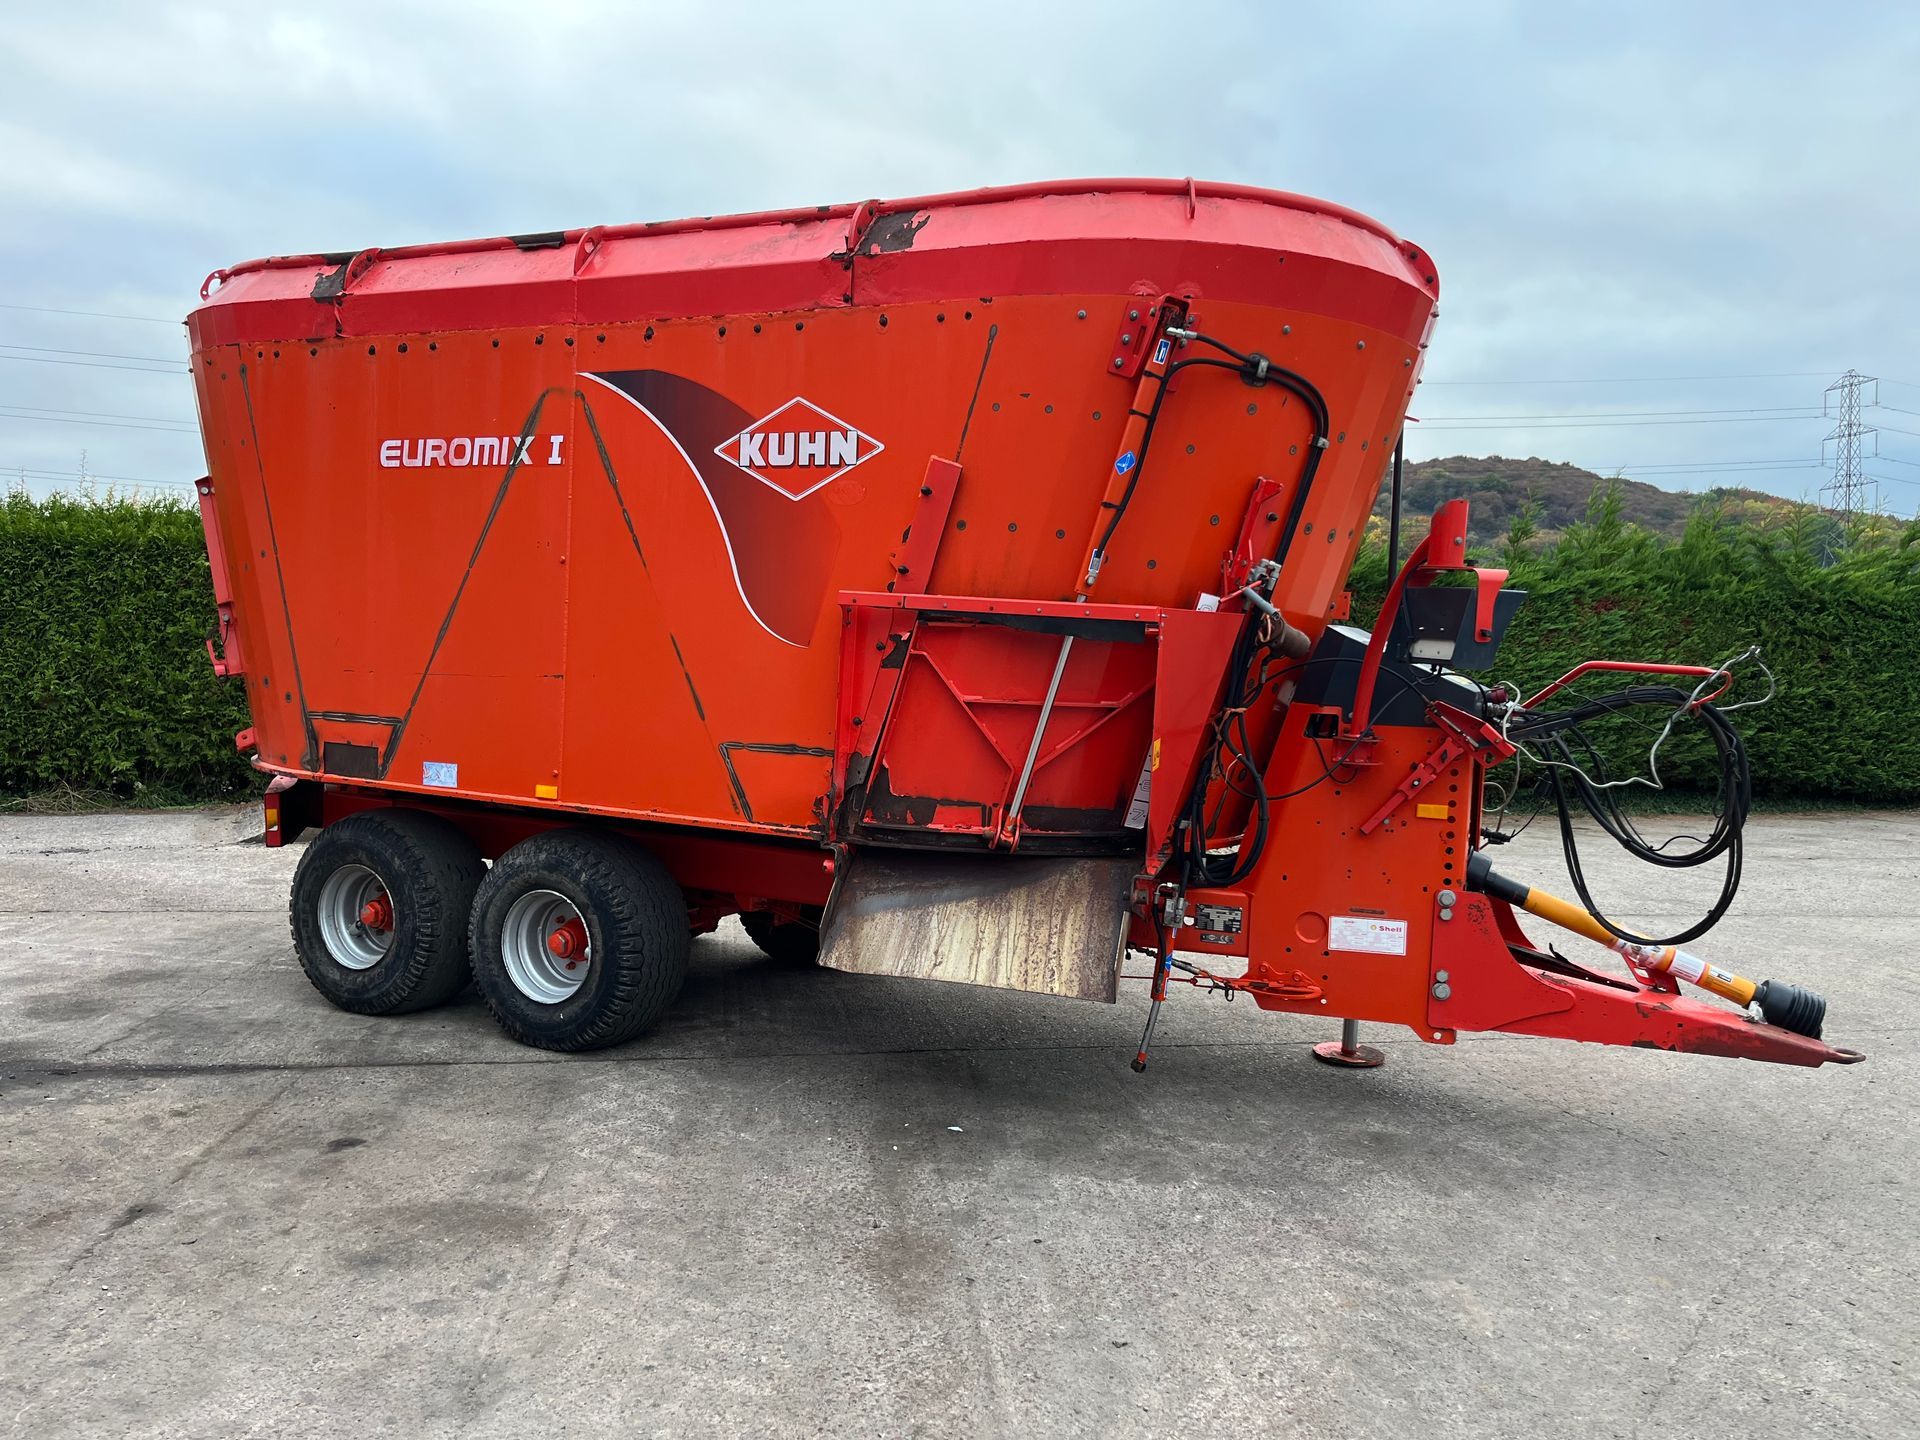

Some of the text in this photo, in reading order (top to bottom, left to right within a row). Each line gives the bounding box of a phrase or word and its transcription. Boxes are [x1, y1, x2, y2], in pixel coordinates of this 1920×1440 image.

[380, 436, 535, 467] EUROMIX
[739, 430, 858, 467] KUHN
[1132, 808, 1145, 821] 7
[1378, 925, 1403, 933] Shell
